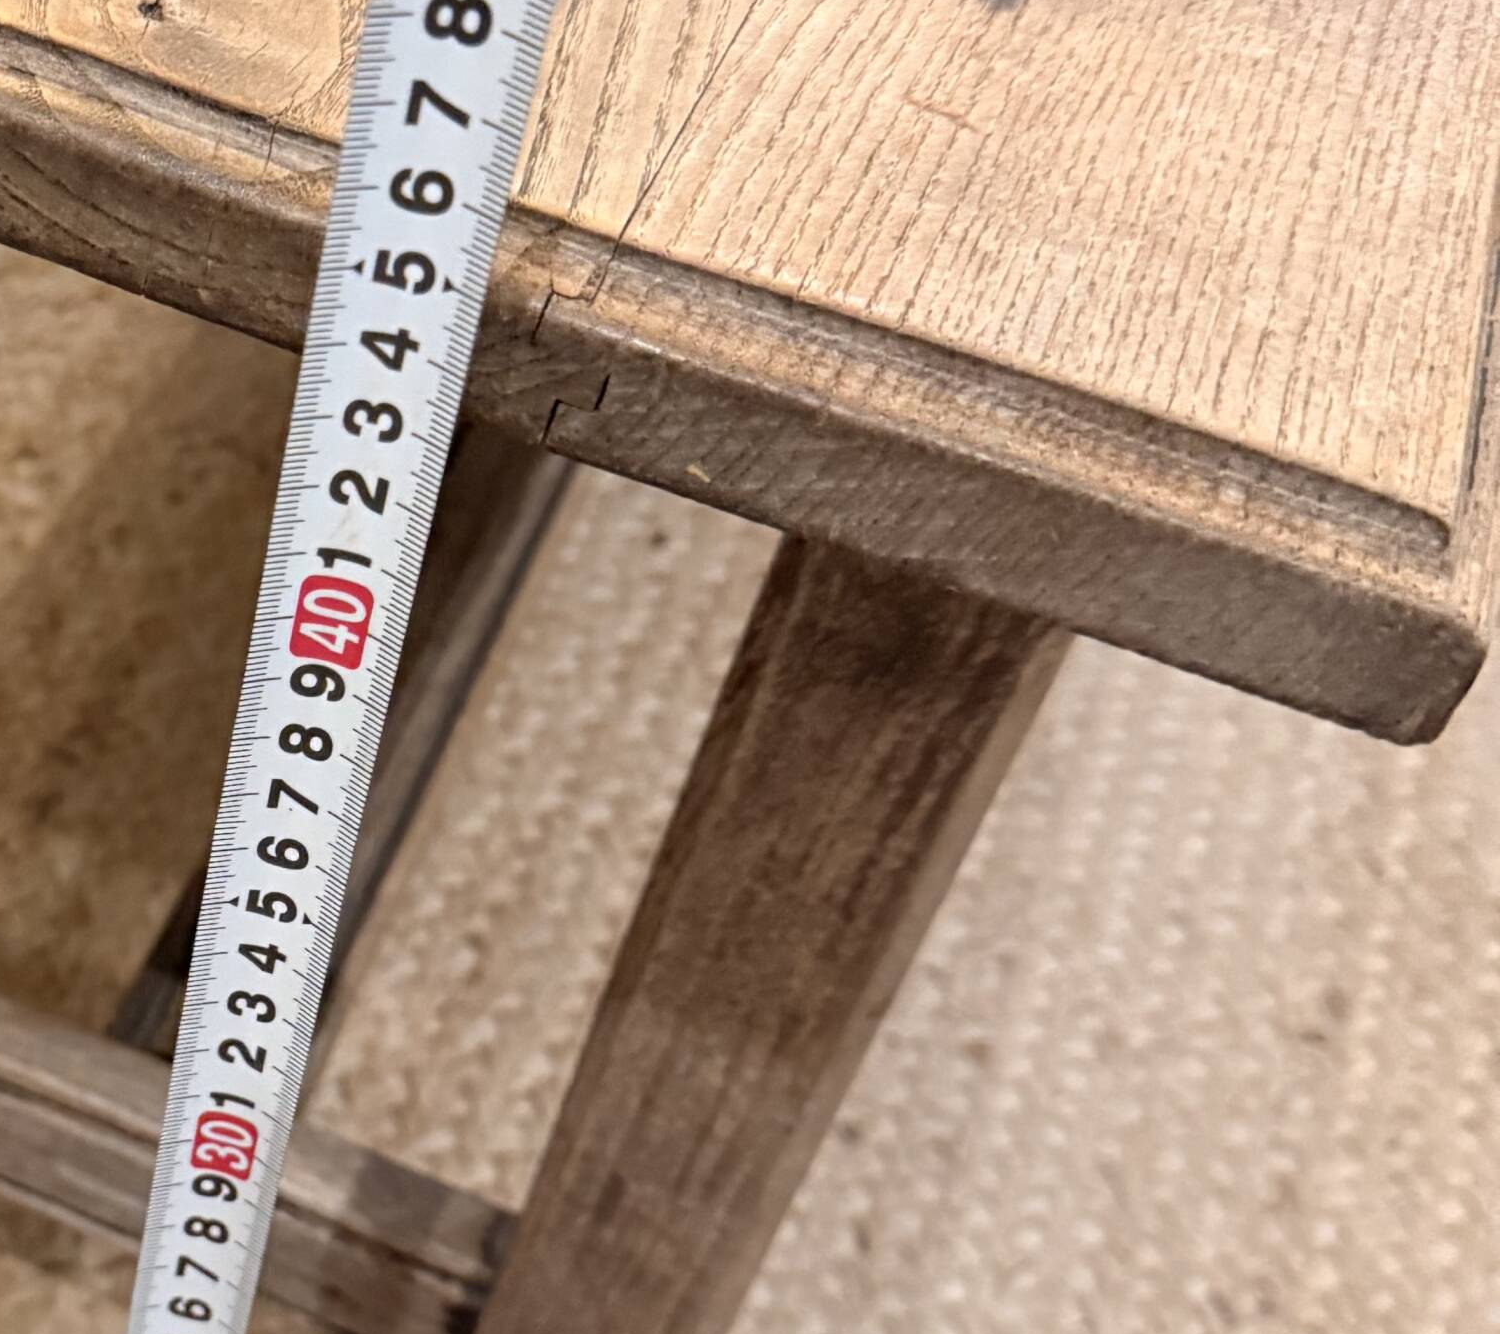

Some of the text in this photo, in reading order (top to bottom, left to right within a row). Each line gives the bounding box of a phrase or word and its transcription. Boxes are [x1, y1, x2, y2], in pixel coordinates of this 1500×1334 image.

[405, 80, 470, 128] 7
[390, 169, 454, 215] 6
[373, 250, 436, 294] 5
[360, 329, 420, 371] 4
[343, 400, 403, 443] 3
[329, 470, 389, 515] 2
[317, 548, 372, 568] 1
[299, 587, 369, 655] 40
[290, 664, 345, 701] 9
[279, 724, 333, 761] 8
[267, 779, 319, 815] 7
[257, 836, 309, 870] 6
[246, 890, 297, 923] 5
[238, 944, 286, 974] 4
[227, 991, 276, 1023] 3
[218, 1039, 266, 1073] 2
[210, 1092, 255, 1109] 1
[197, 1116, 254, 1173] 30
[192, 1174, 238, 1202] 9
[184, 1216, 229, 1244] 8
[175, 1256, 219, 1282] 7
[168, 1297, 212, 1322] 6
